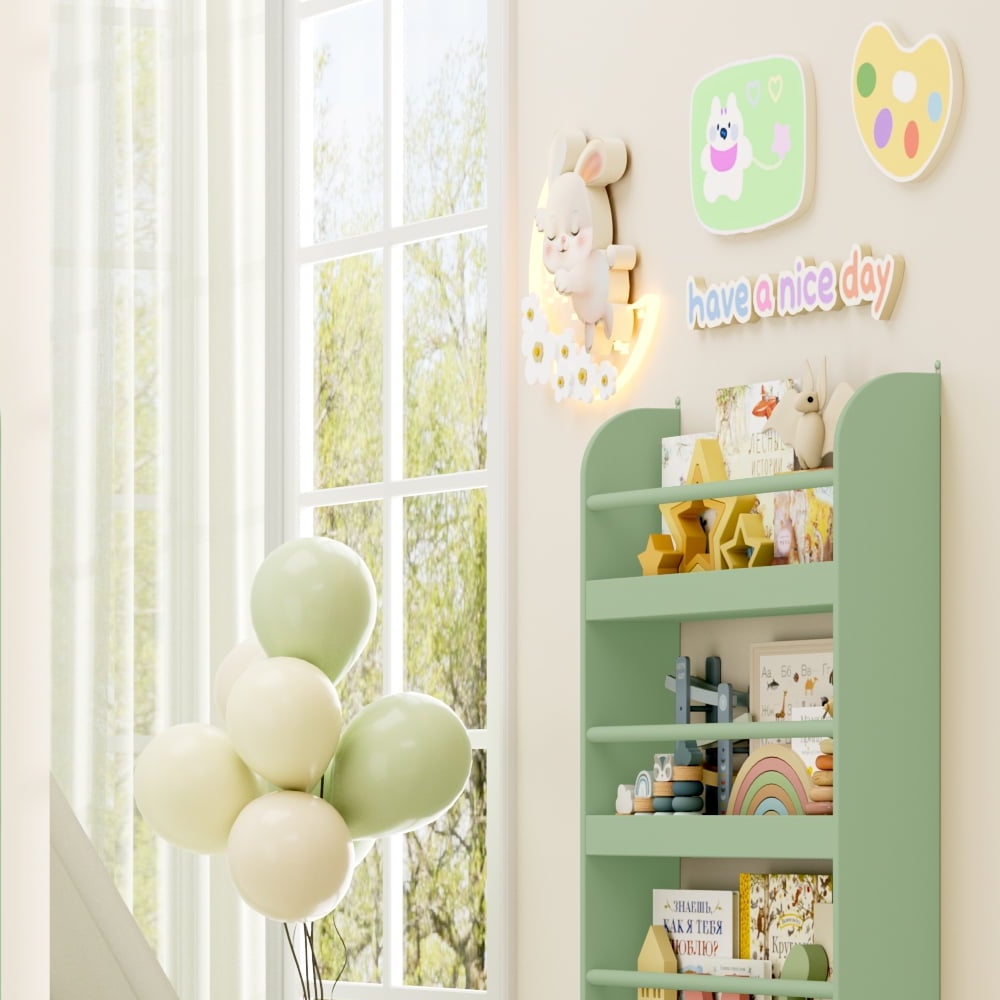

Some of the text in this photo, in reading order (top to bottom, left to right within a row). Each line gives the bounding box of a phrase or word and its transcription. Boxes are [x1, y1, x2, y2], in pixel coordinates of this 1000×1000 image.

[688, 249, 891, 324] have a nice day
[673, 900, 713, 915] ЗНАЕШЬ,
[663, 918, 723, 935] КАК Я ТЕБЯ
[671, 939, 719, 957] ЮБЛЮ?
